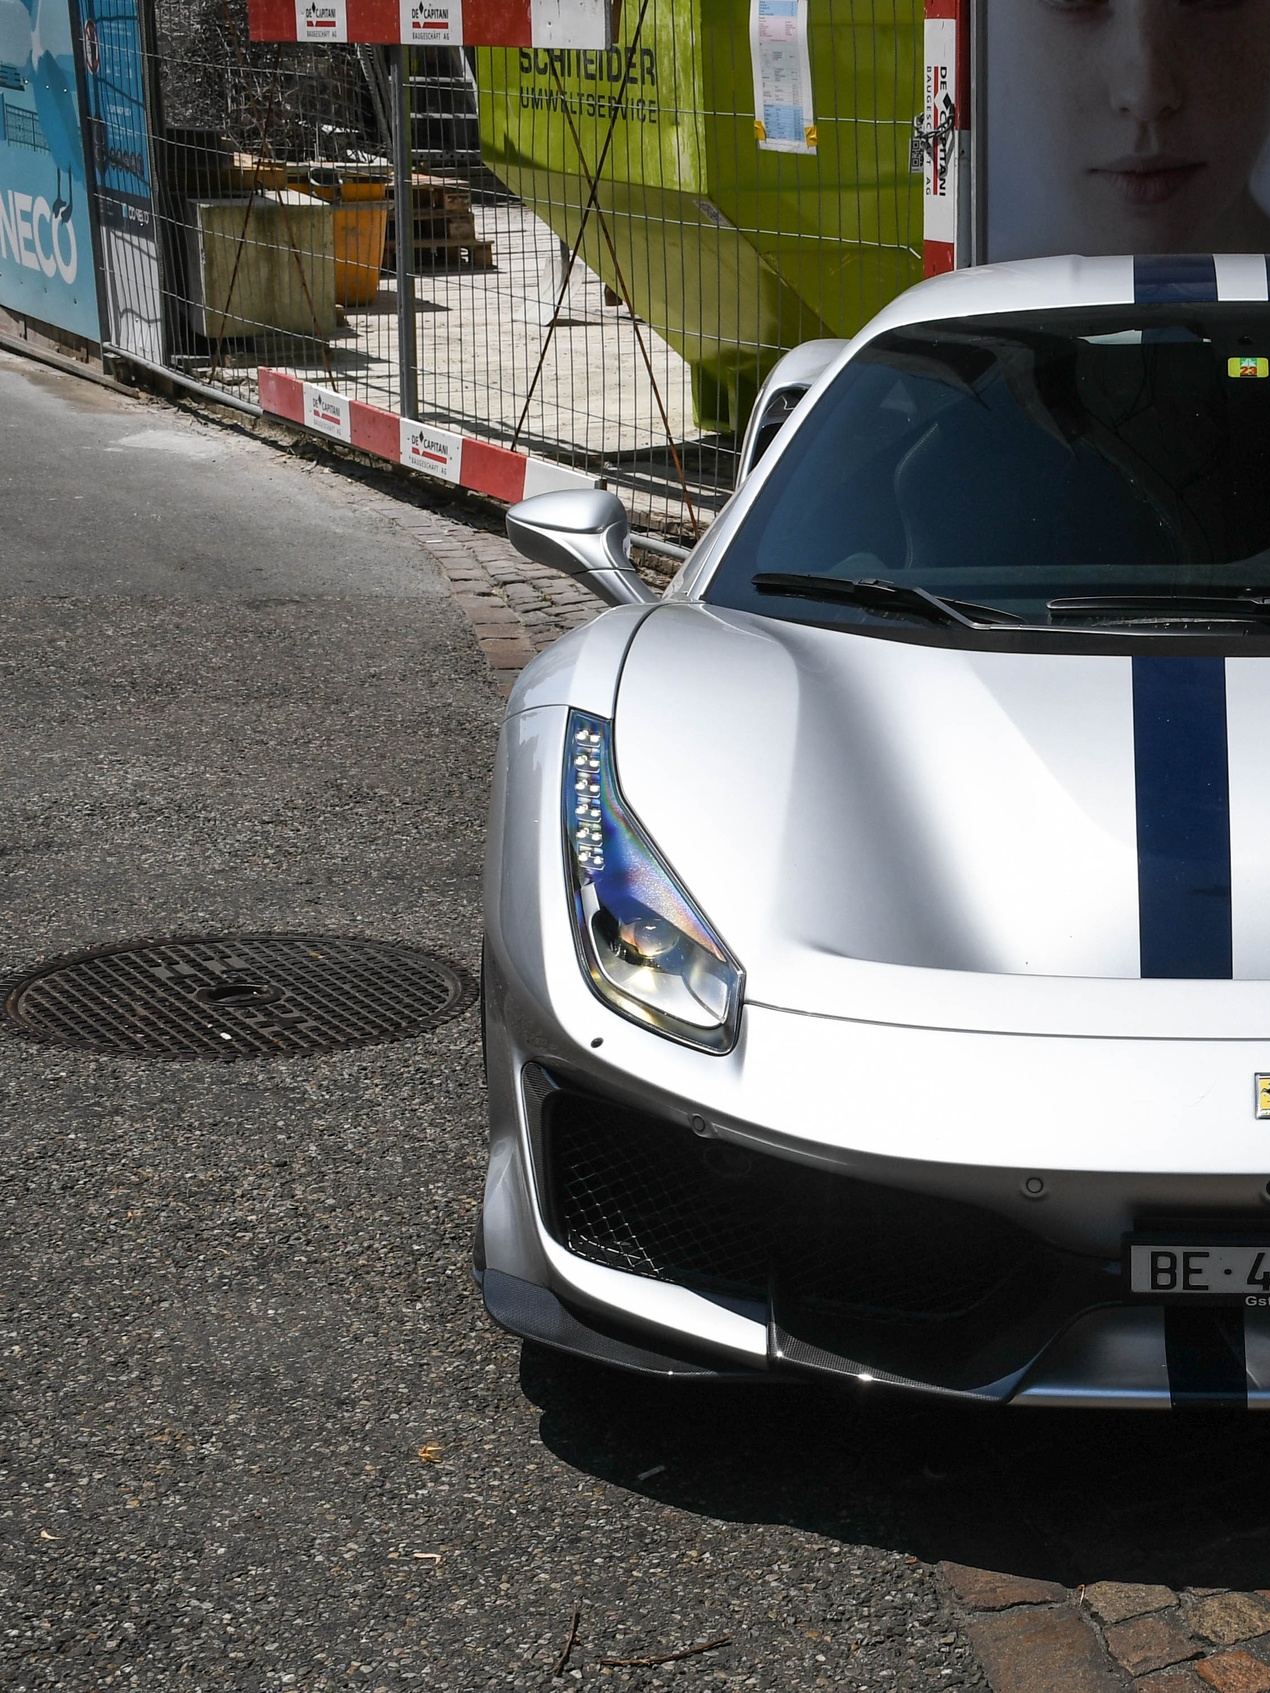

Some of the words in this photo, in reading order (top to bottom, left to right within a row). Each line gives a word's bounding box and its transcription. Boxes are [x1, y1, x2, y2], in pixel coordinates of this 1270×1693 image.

[305, 8, 312, 18] DE
[316, 8, 336, 18] CAPITANI
[412, 9, 419, 19] DE
[424, 9, 449, 19] CAPITANI
[443, 33, 450, 41] AG
[939, 66, 948, 91] DE
[520, 86, 657, 124] UMWELTSERVICE
[925, 177, 932, 196] AG
[1240, 366, 1258, 376] 23
[313, 397, 319, 409] DE
[321, 402, 341, 417] CAPITANI
[411, 435, 419, 446] DE
[423, 439, 449, 456] CAPITANI
[441, 467, 447, 475] AG
[1150, 1251, 1210, 1291] BE
